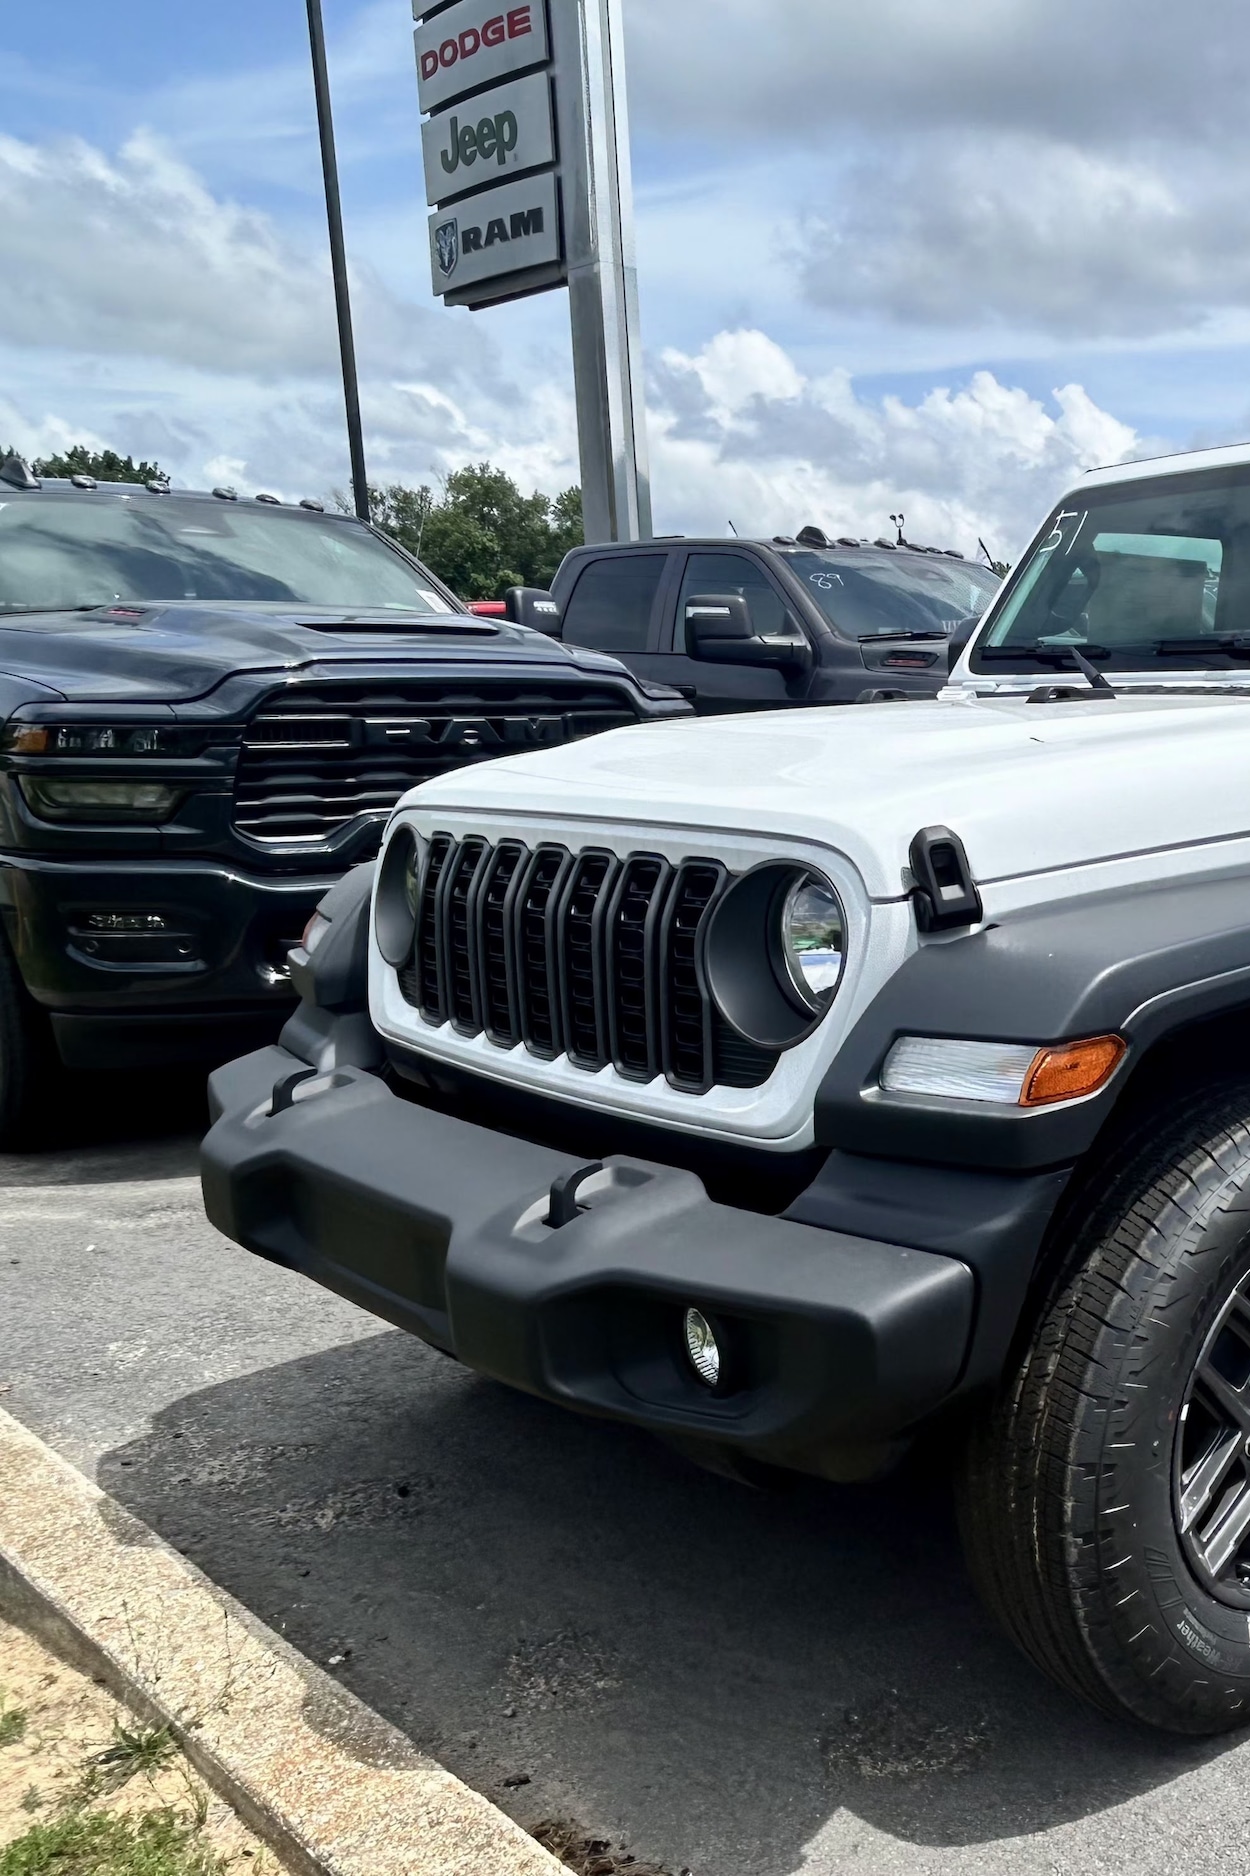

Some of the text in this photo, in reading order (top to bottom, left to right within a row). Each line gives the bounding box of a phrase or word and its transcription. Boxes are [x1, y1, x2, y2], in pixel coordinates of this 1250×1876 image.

[420, 5, 532, 81] DODGE
[440, 110, 518, 174] Jeep
[462, 207, 544, 255] RAM
[1040, 509, 1088, 556] 51
[364, 716, 564, 745] RAM
